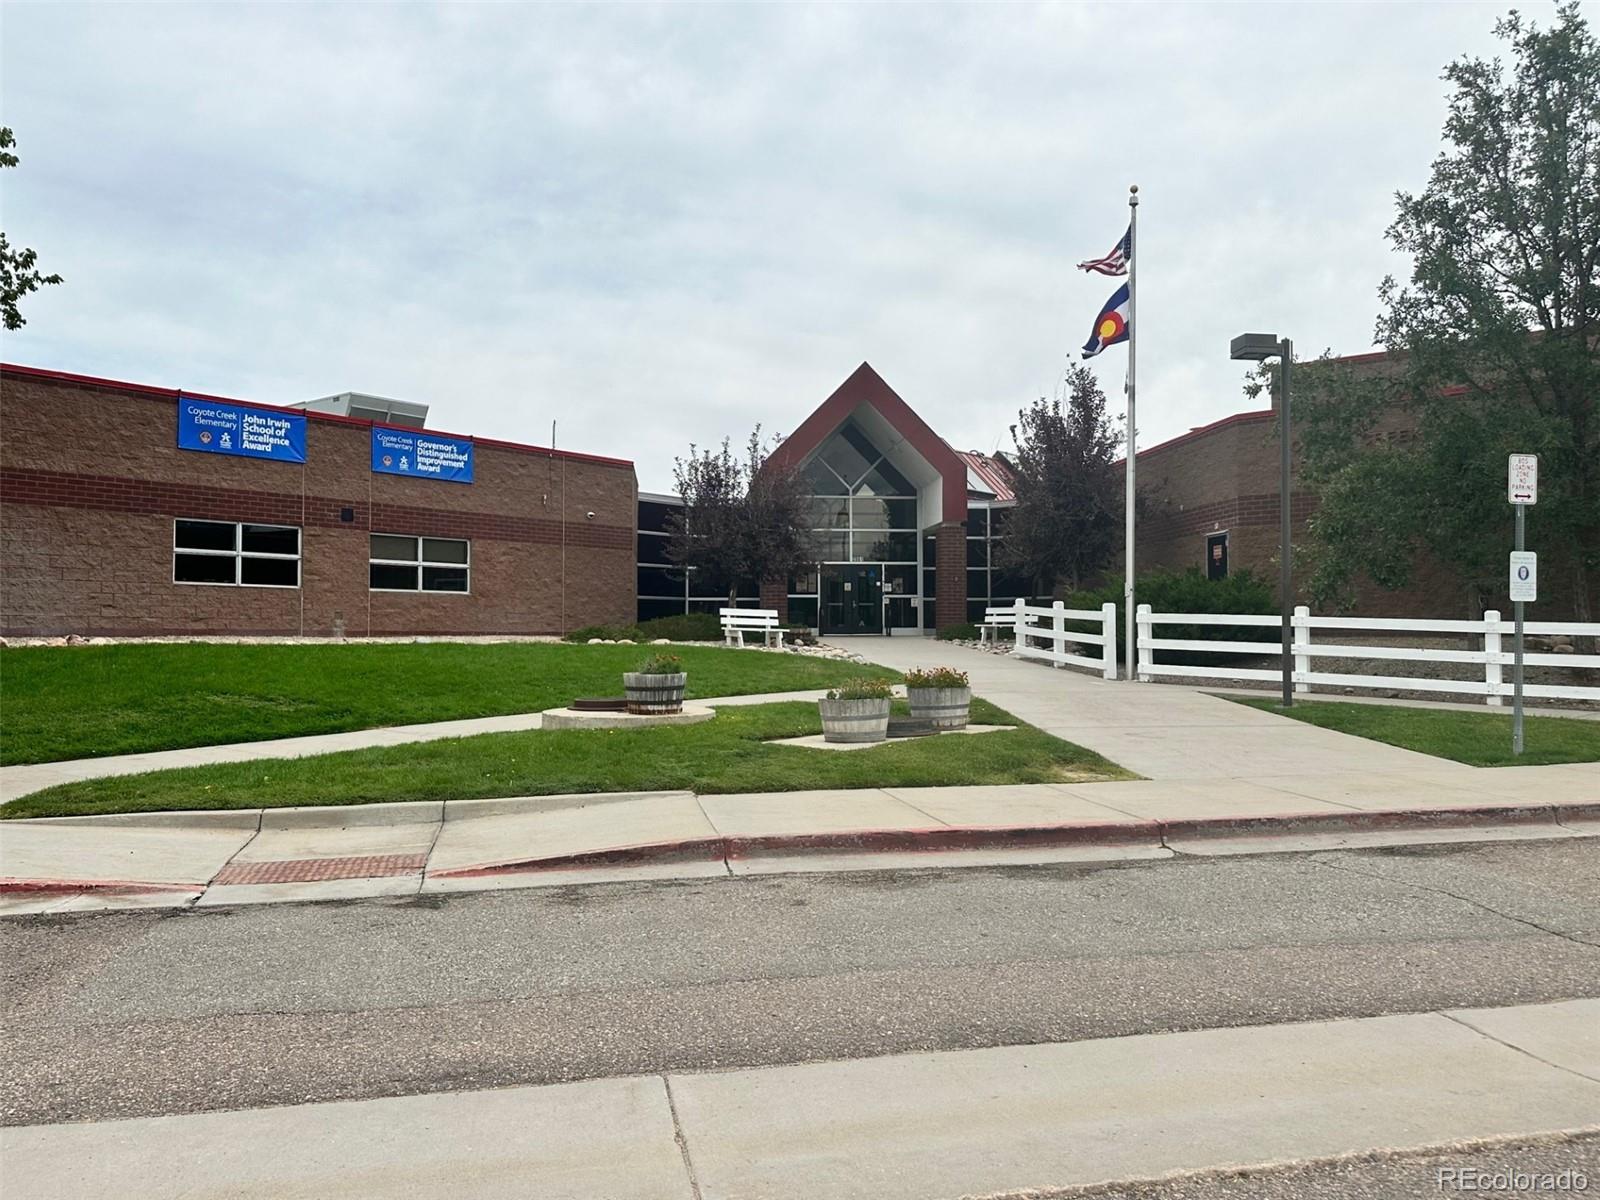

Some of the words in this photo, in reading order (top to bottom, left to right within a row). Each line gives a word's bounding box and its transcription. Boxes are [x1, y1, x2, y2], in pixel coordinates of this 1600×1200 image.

[187, 406, 215, 418] Coyote
[216, 410, 237, 420] Creek
[195, 416, 237, 430] Elementary
[243, 414, 266, 425] John
[267, 418, 291, 429] Irwin
[243, 423, 274, 435] School
[275, 427, 286, 437] of
[243, 432, 290, 446] Excellence
[377, 433, 397, 443] Coyote
[398, 436, 413, 445] Creek
[243, 441, 272, 452] Award
[383, 441, 413, 452] Elementary
[417, 440, 457, 452] Governor's
[417, 448, 468, 461] Distinguished
[417, 456, 465, 468] Improvement
[417, 463, 441, 473] Award
[1512, 463, 1534, 471] LOADING
[1511, 483, 1534, 491] PARKING
